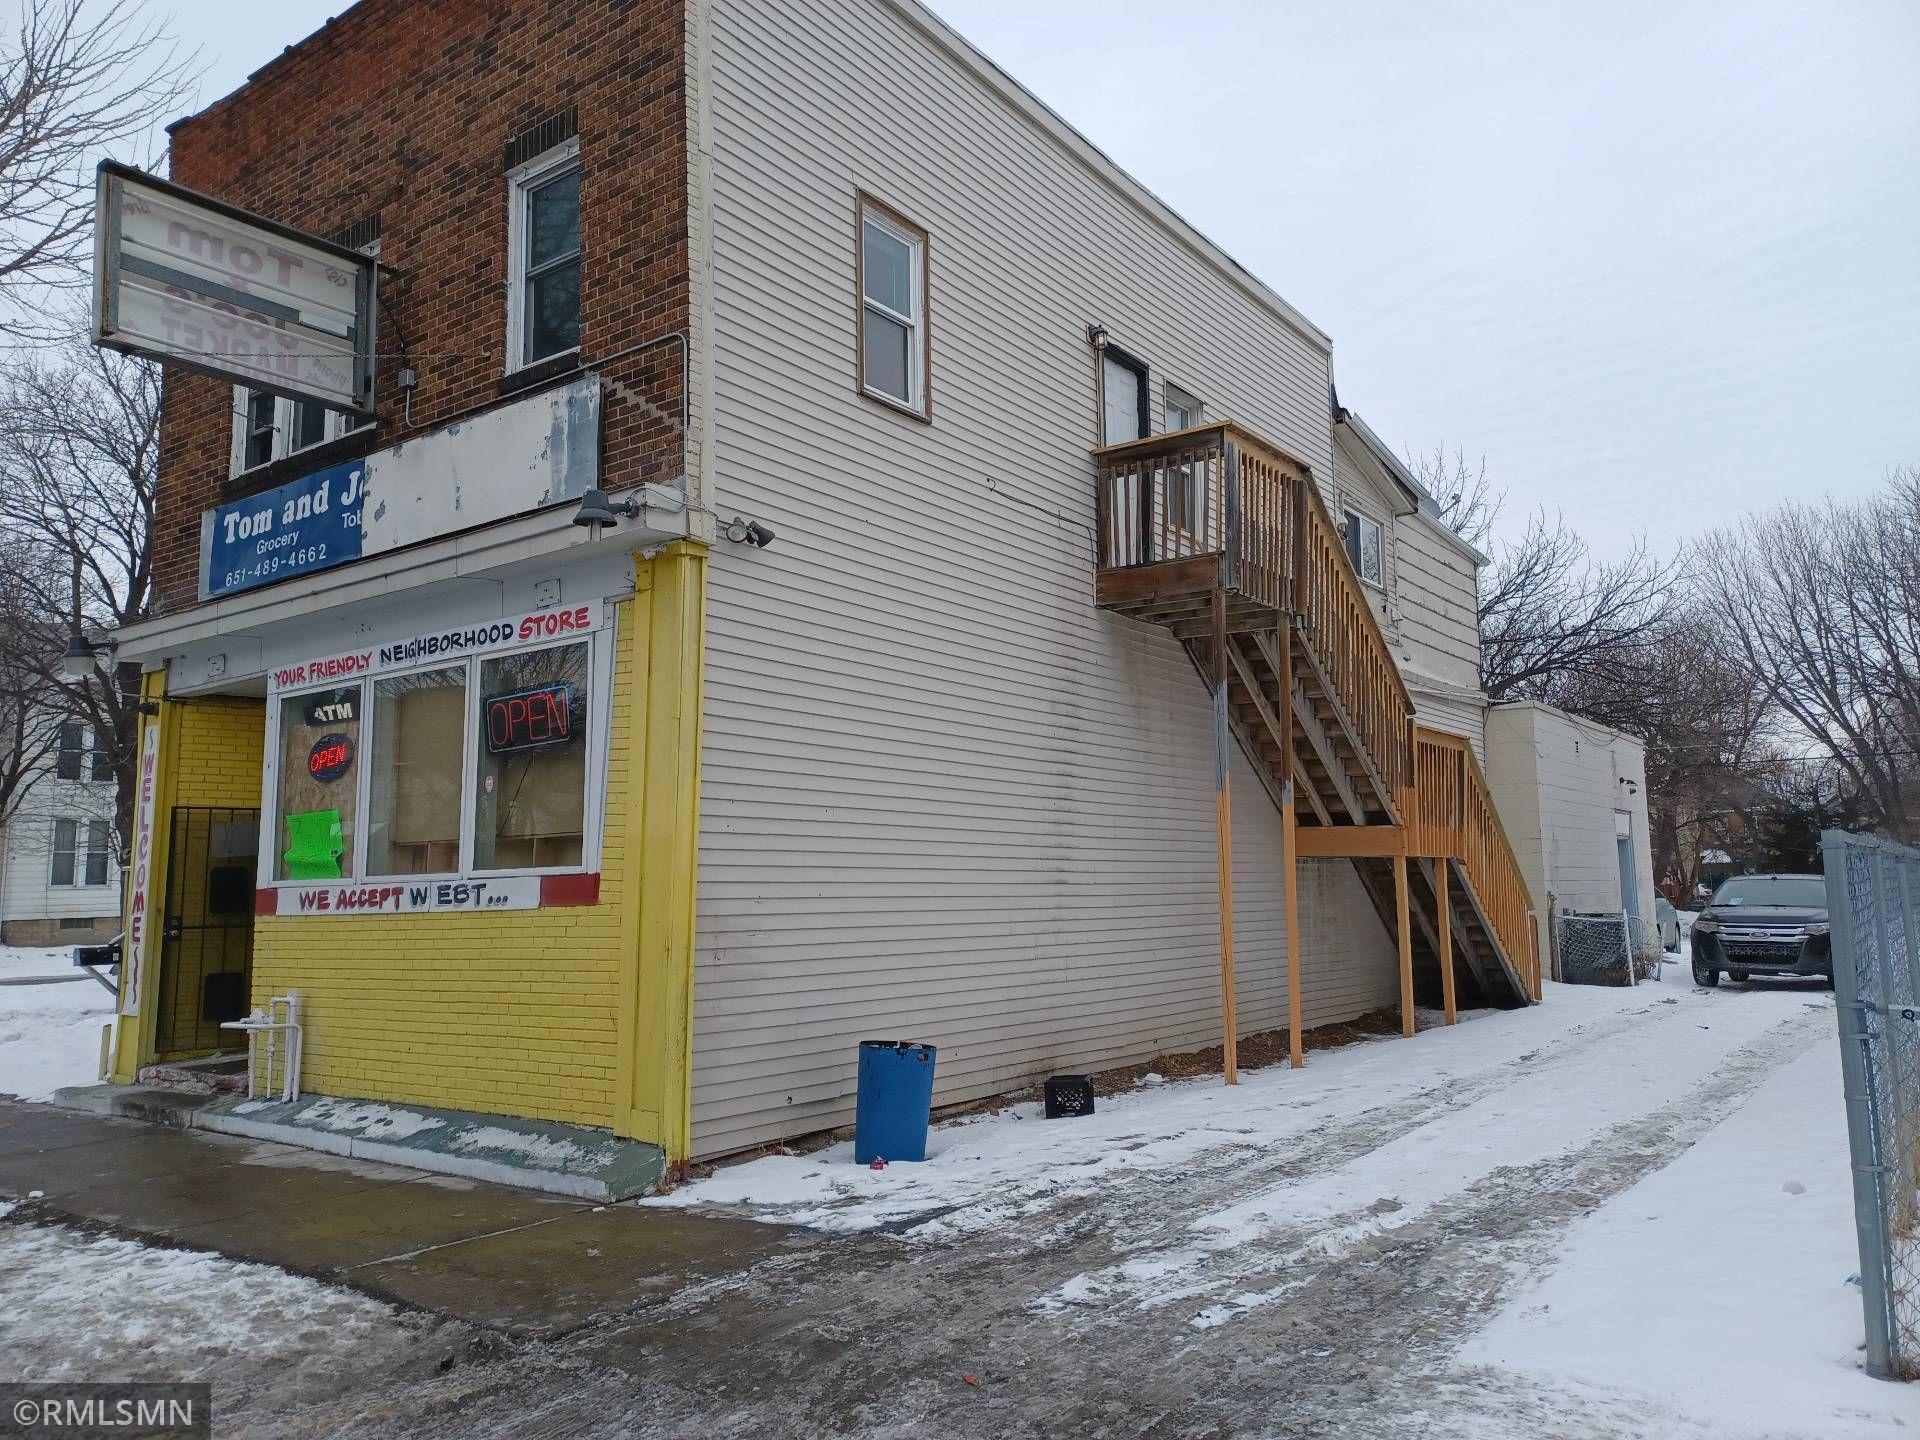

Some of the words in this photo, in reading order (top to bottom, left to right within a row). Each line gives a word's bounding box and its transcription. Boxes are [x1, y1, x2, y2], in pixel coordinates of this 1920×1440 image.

[224, 508, 273, 544] Tom
[282, 480, 329, 524] and
[256, 530, 300, 555] Grocery
[225, 543, 327, 587] 651-489-4662
[273, 665, 305, 690] YOUR
[309, 651, 373, 682] FRIENDLY
[379, 623, 515, 663] NEIGHBORHOOD
[518, 606, 591, 640] STORE
[314, 702, 353, 722] ATM
[490, 687, 568, 745] OPEN
[310, 745, 348, 772] OPEN
[131, 754, 156, 943] WELCOME
[299, 890, 331, 911] WE
[335, 887, 404, 910] ACCEPT
